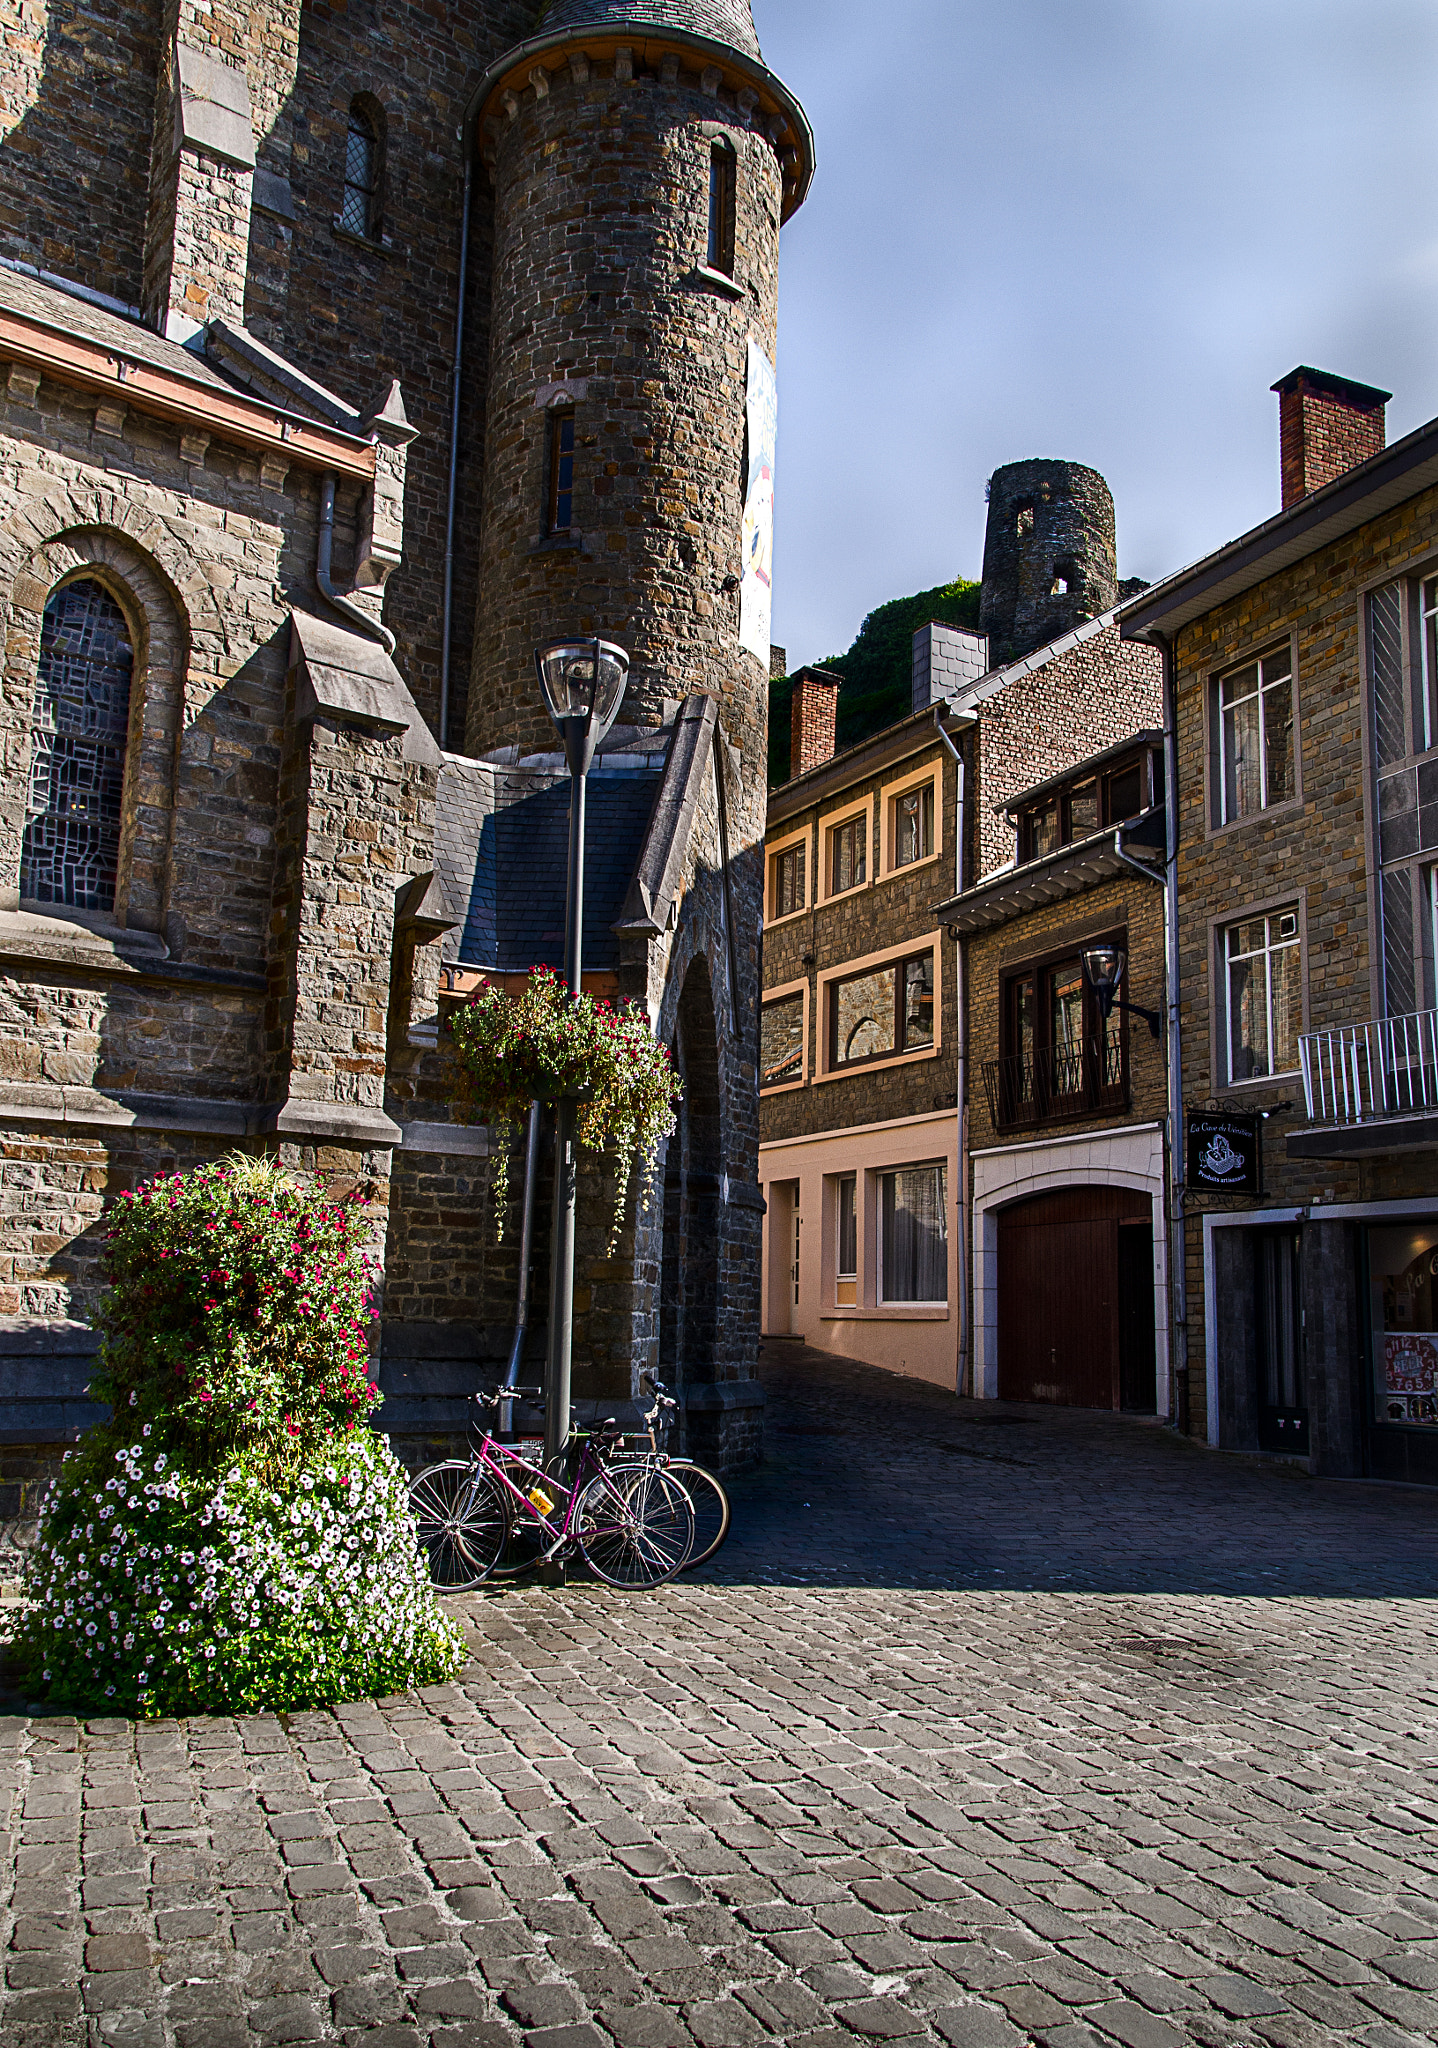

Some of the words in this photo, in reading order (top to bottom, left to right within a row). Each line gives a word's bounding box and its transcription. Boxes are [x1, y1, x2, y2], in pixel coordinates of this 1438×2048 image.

[1190, 1123, 1200, 1134] La
[1201, 1122, 1218, 1132] Cave
[1218, 1122, 1227, 1132] du
[1198, 1169, 1220, 1183] Produits
[1393, 1355, 1424, 1374] BEER
